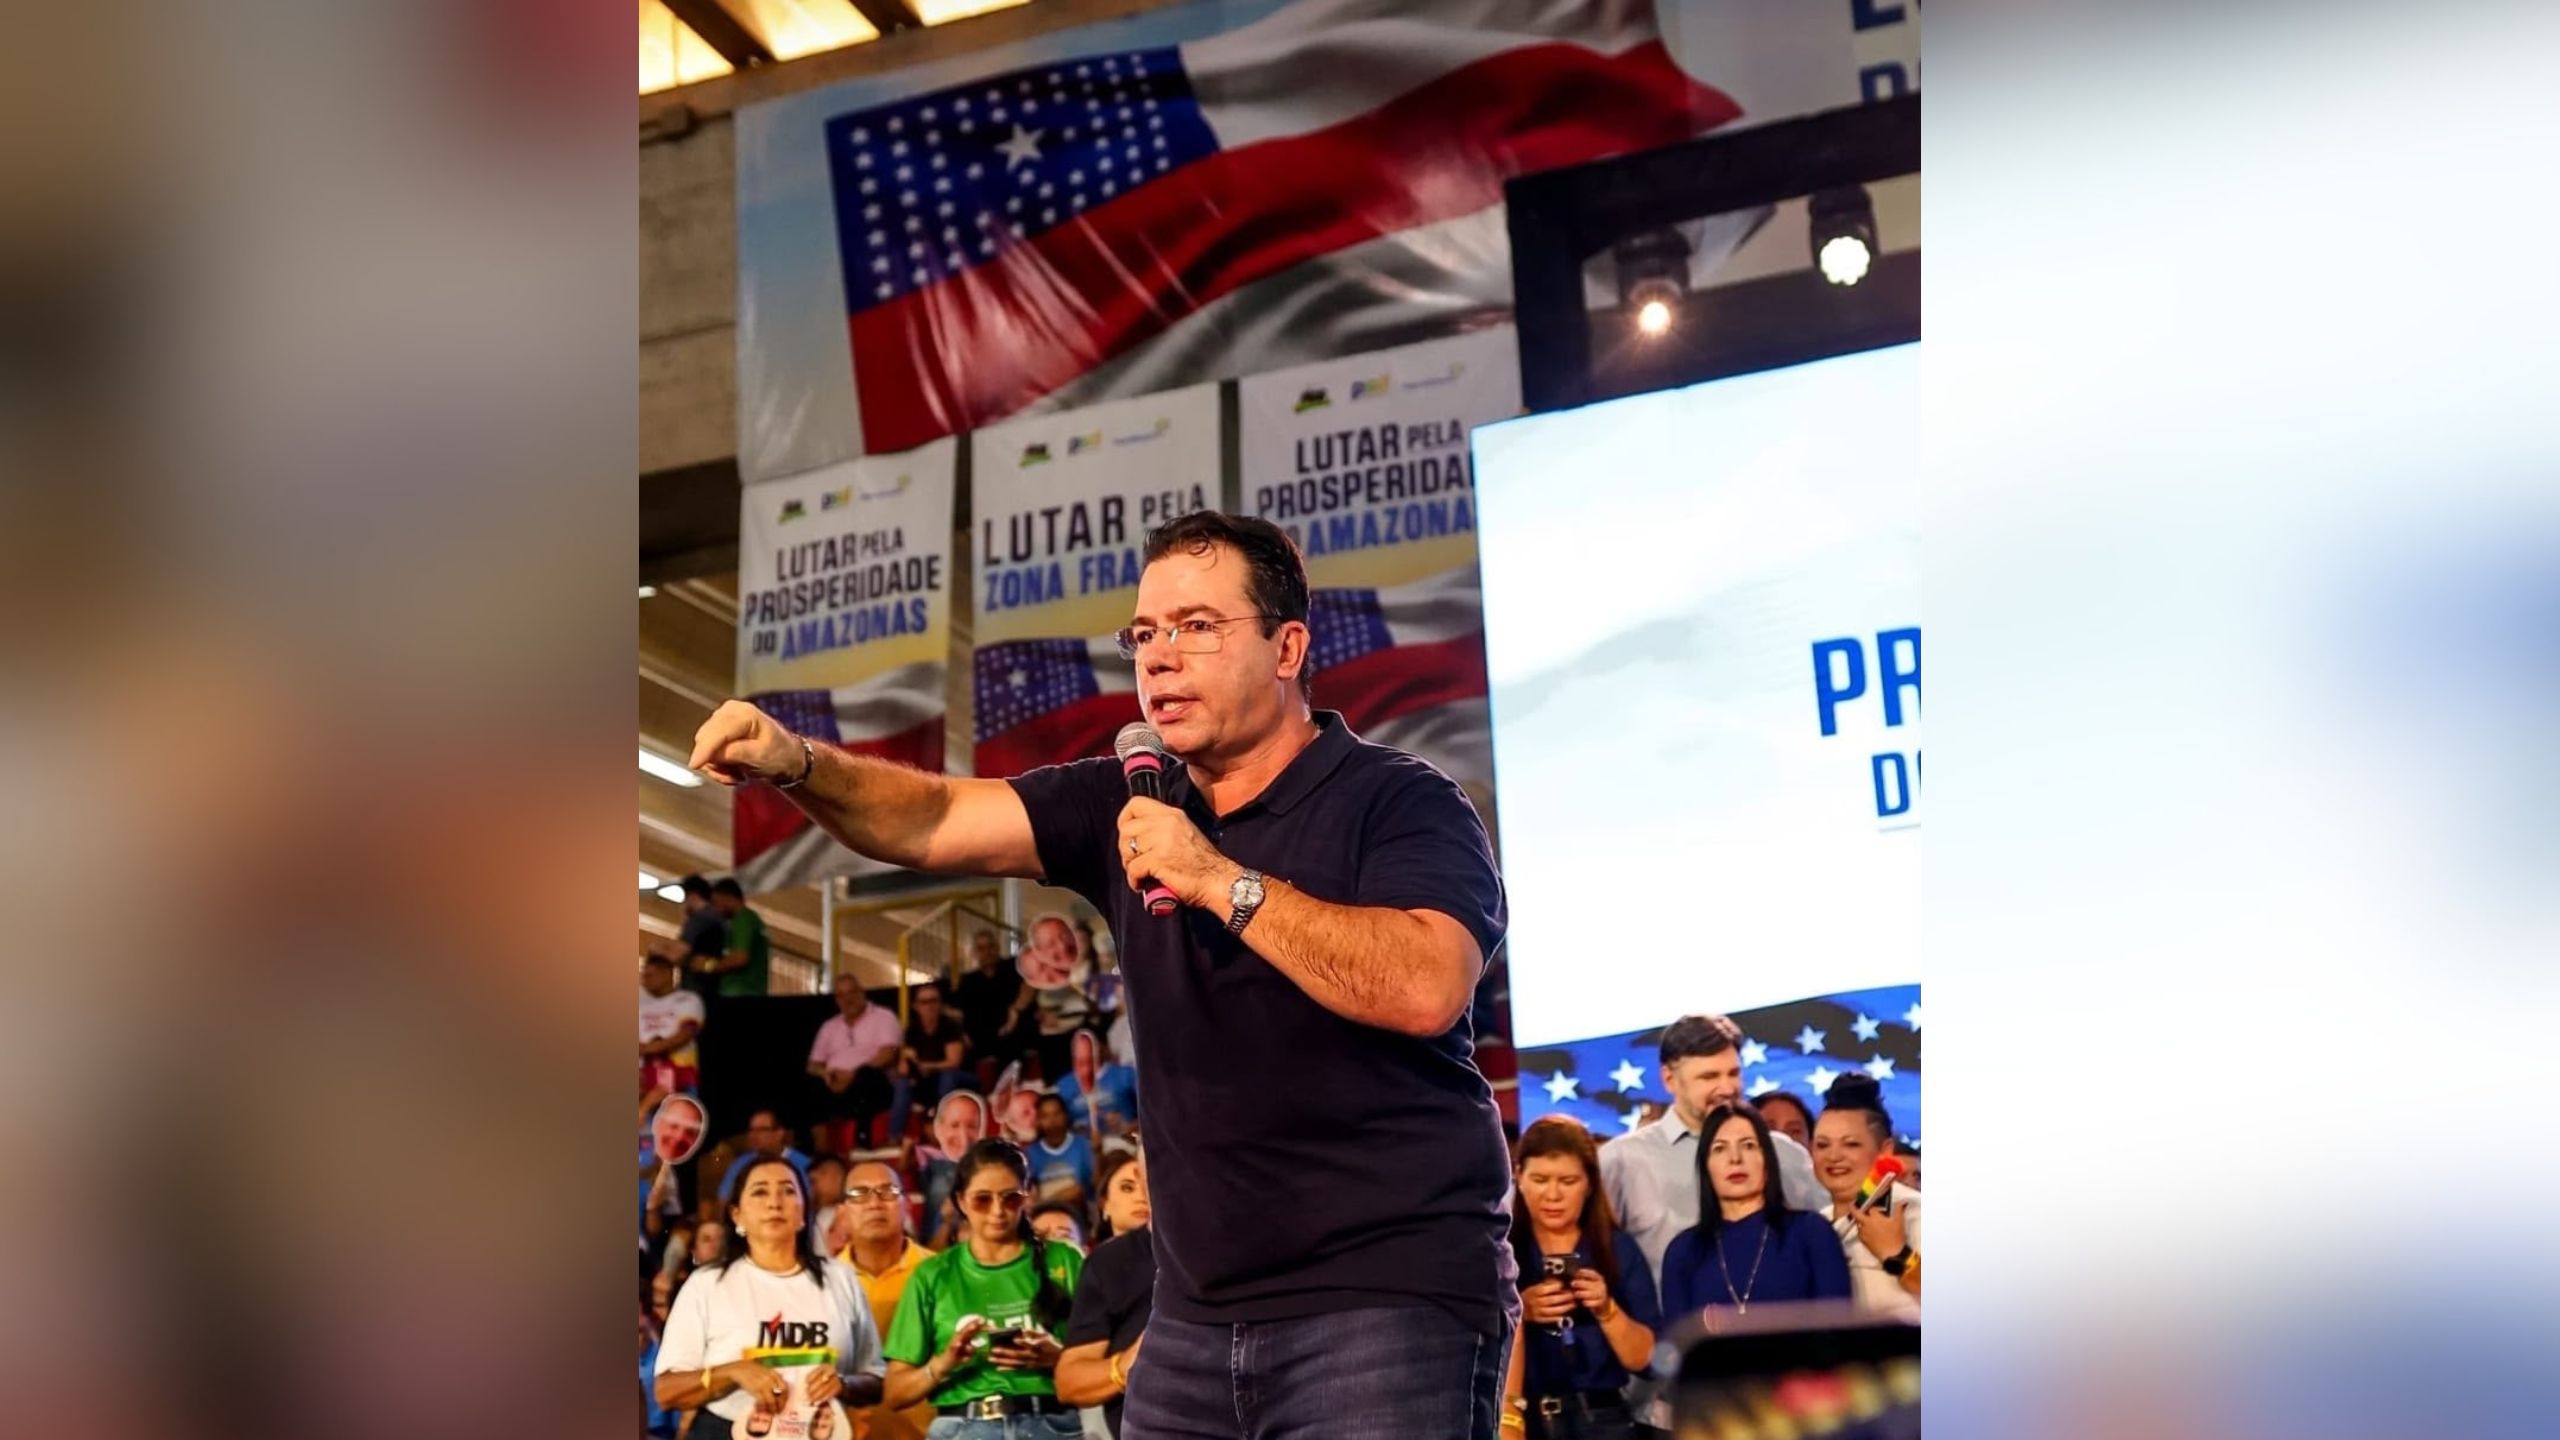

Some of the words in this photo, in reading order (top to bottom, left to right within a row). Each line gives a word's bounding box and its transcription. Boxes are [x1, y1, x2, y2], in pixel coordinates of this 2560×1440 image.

[1296, 423, 1399, 474] LUTAR
[1406, 418, 1463, 450] PELA
[1258, 453, 1474, 519] PROSPERIDA
[776, 531, 857, 581] LUTAR
[860, 527, 905, 557] PELA
[983, 494, 1124, 566] LUTAR
[1141, 482, 1205, 523] PELA
[1307, 496, 1474, 556] AMAZONA
[743, 554, 941, 627] PROSPERIDADE
[985, 562, 1064, 612] ZONA
[753, 630, 776, 655] DO
[781, 597, 928, 660] AMAZONAS
[1872, 750, 1921, 817] D
[757, 1320, 829, 1348] MDB
